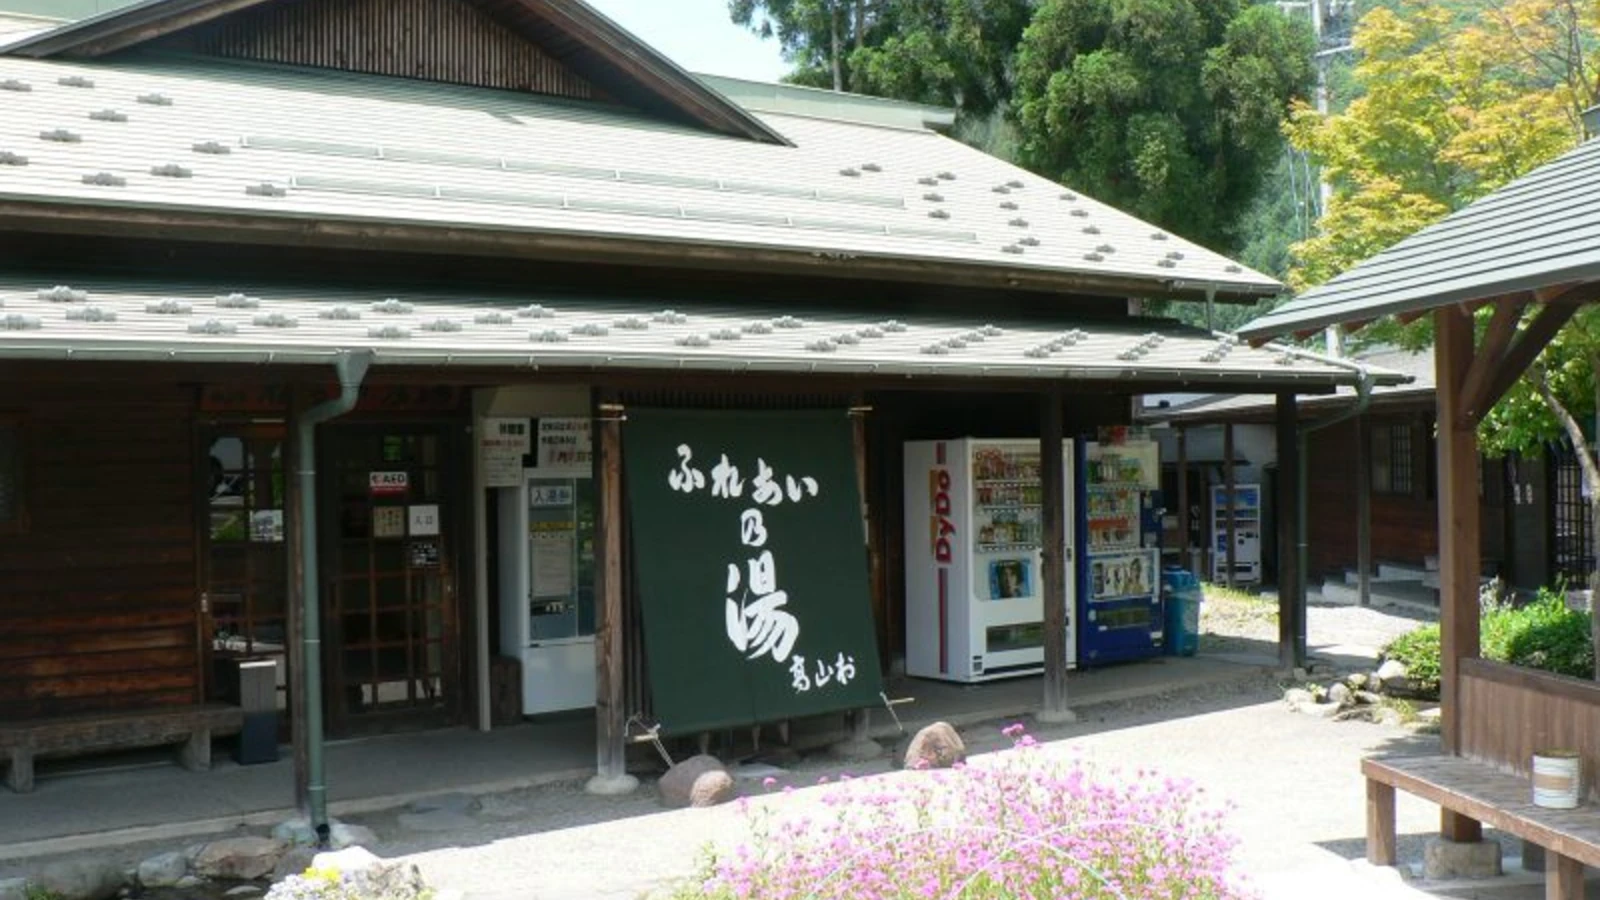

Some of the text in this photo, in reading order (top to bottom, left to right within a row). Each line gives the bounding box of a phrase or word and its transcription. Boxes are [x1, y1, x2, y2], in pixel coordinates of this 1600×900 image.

[383, 473, 405, 484] AED
[668, 443, 819, 506] ふれあい
[935, 469, 956, 564] DyDo
[725, 549, 800, 663] 湯
